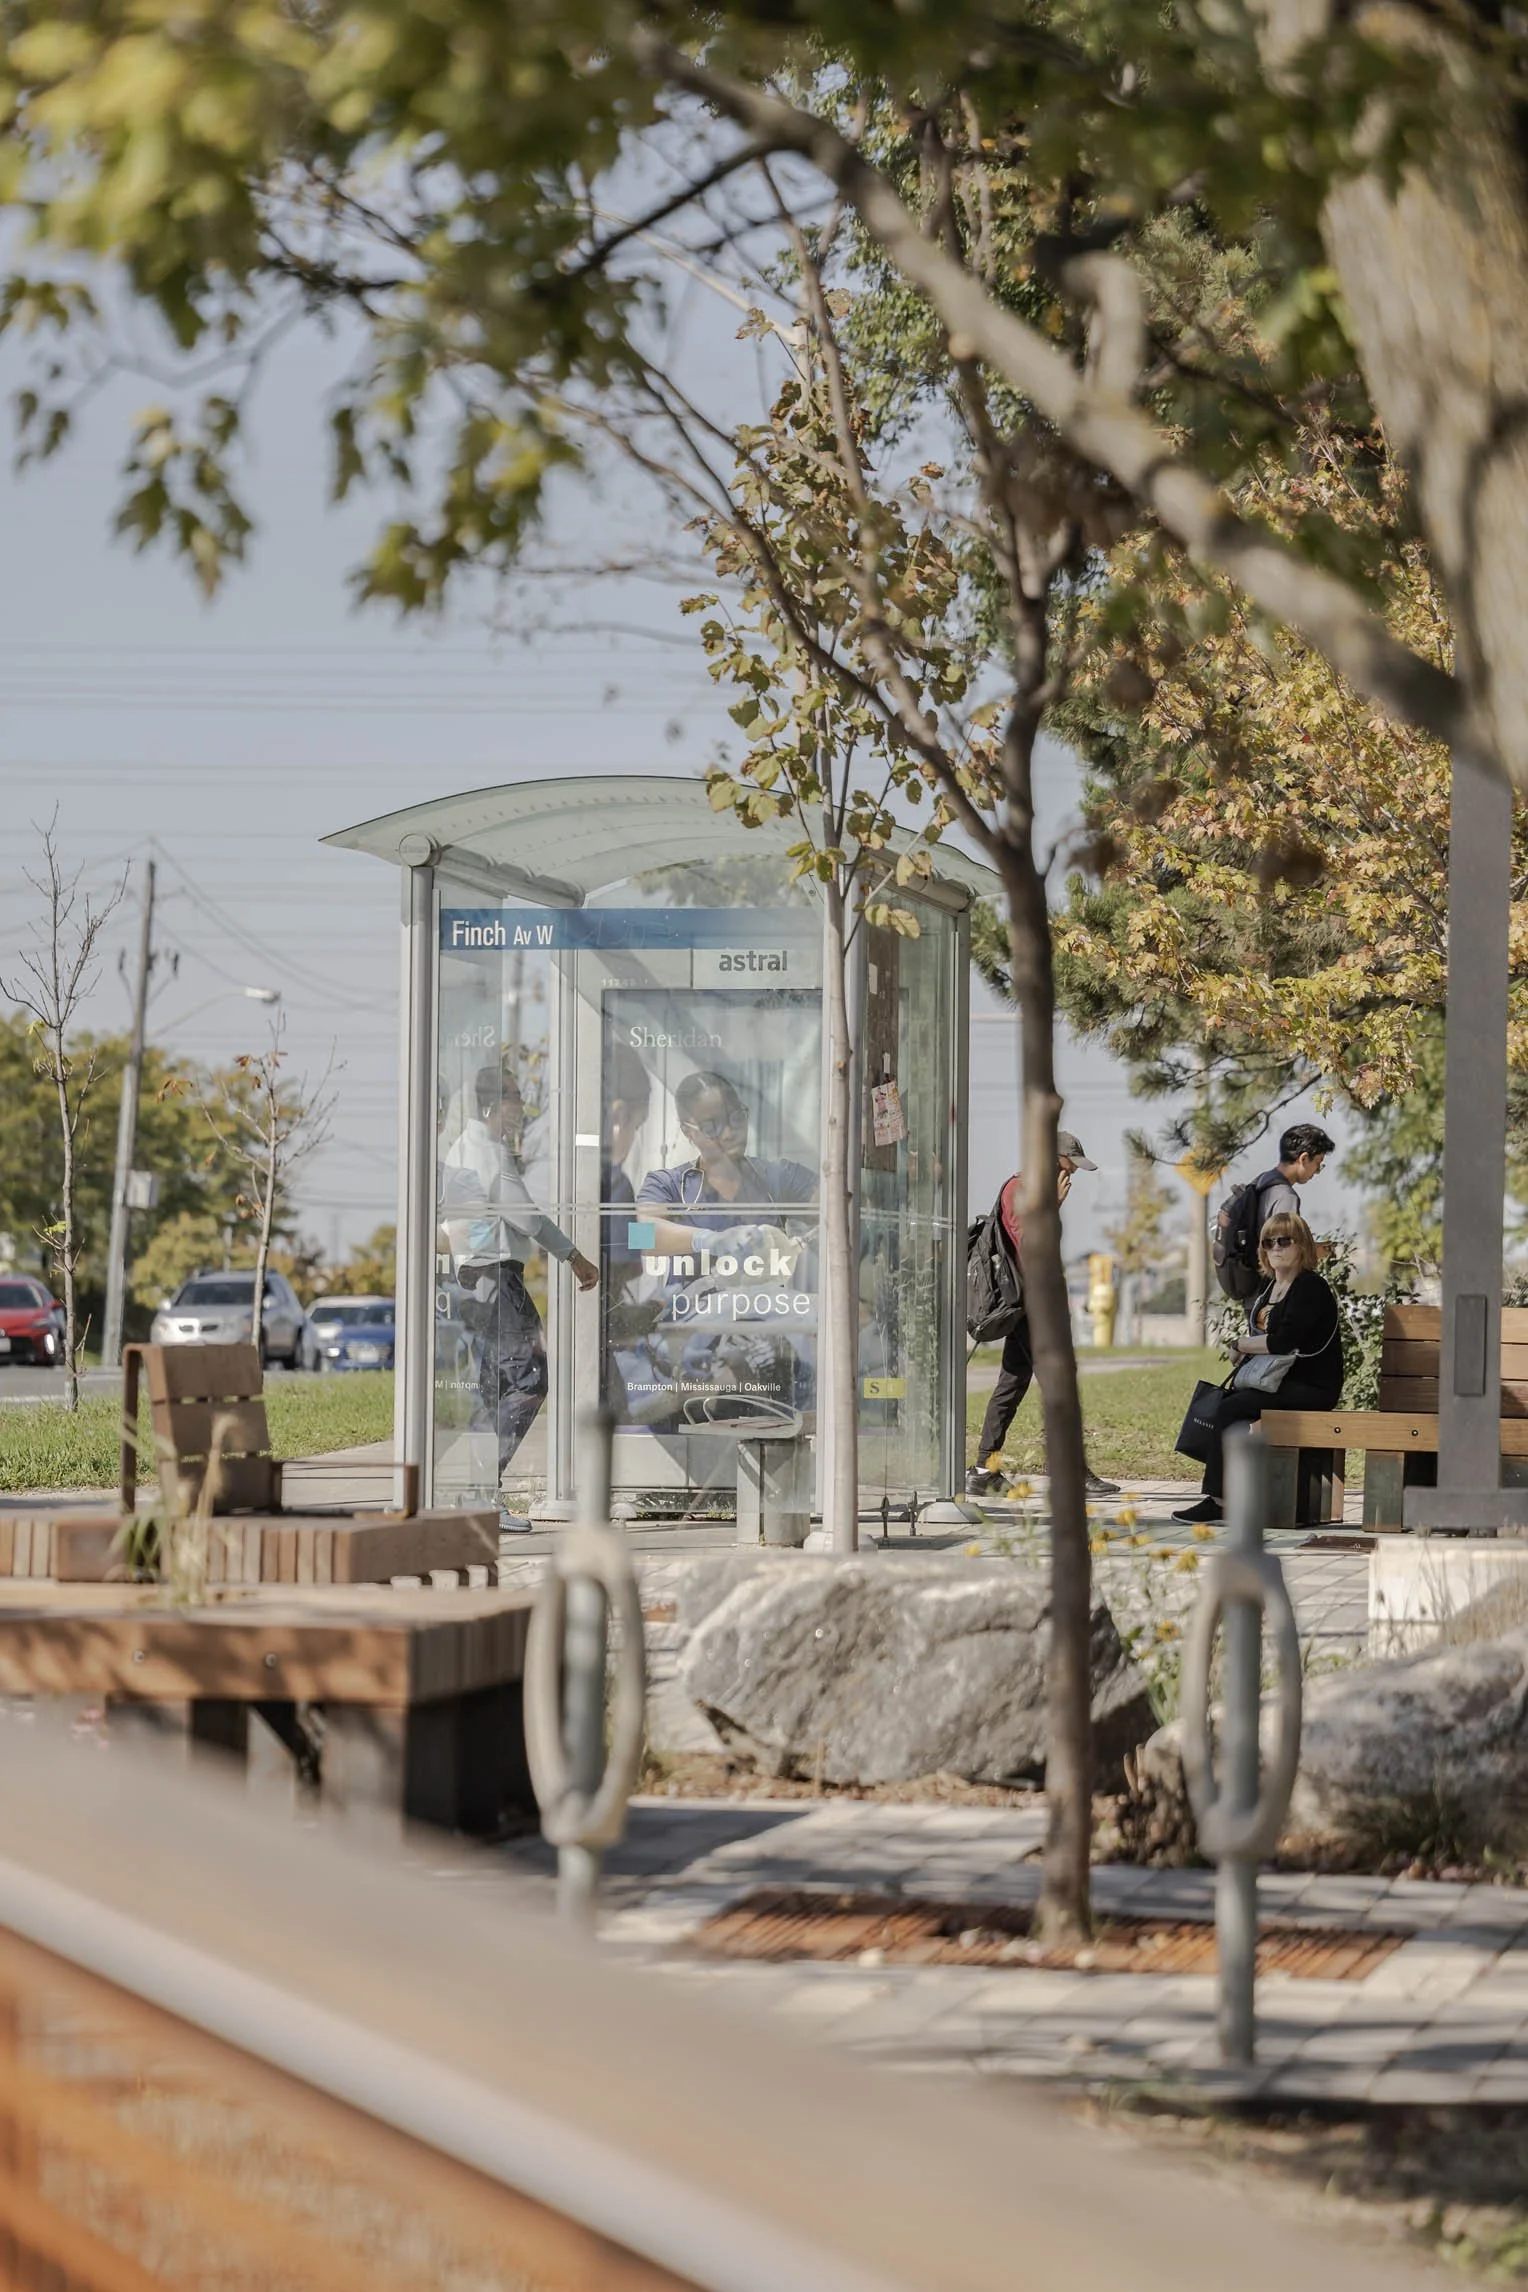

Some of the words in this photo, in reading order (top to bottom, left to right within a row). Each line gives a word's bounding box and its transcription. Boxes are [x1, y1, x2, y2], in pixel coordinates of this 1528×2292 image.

[452, 920, 506, 946] Finch
[513, 925, 532, 945] Av
[536, 925, 554, 945] W
[719, 950, 788, 972] astral
[629, 1026, 722, 1048] Sheridan
[645, 1248, 793, 1276] unlock
[672, 1292, 810, 1321] purpose
[627, 1382, 673, 1393] Brampton
[681, 1382, 737, 1393] Mississauga
[744, 1382, 782, 1392] Oakville
